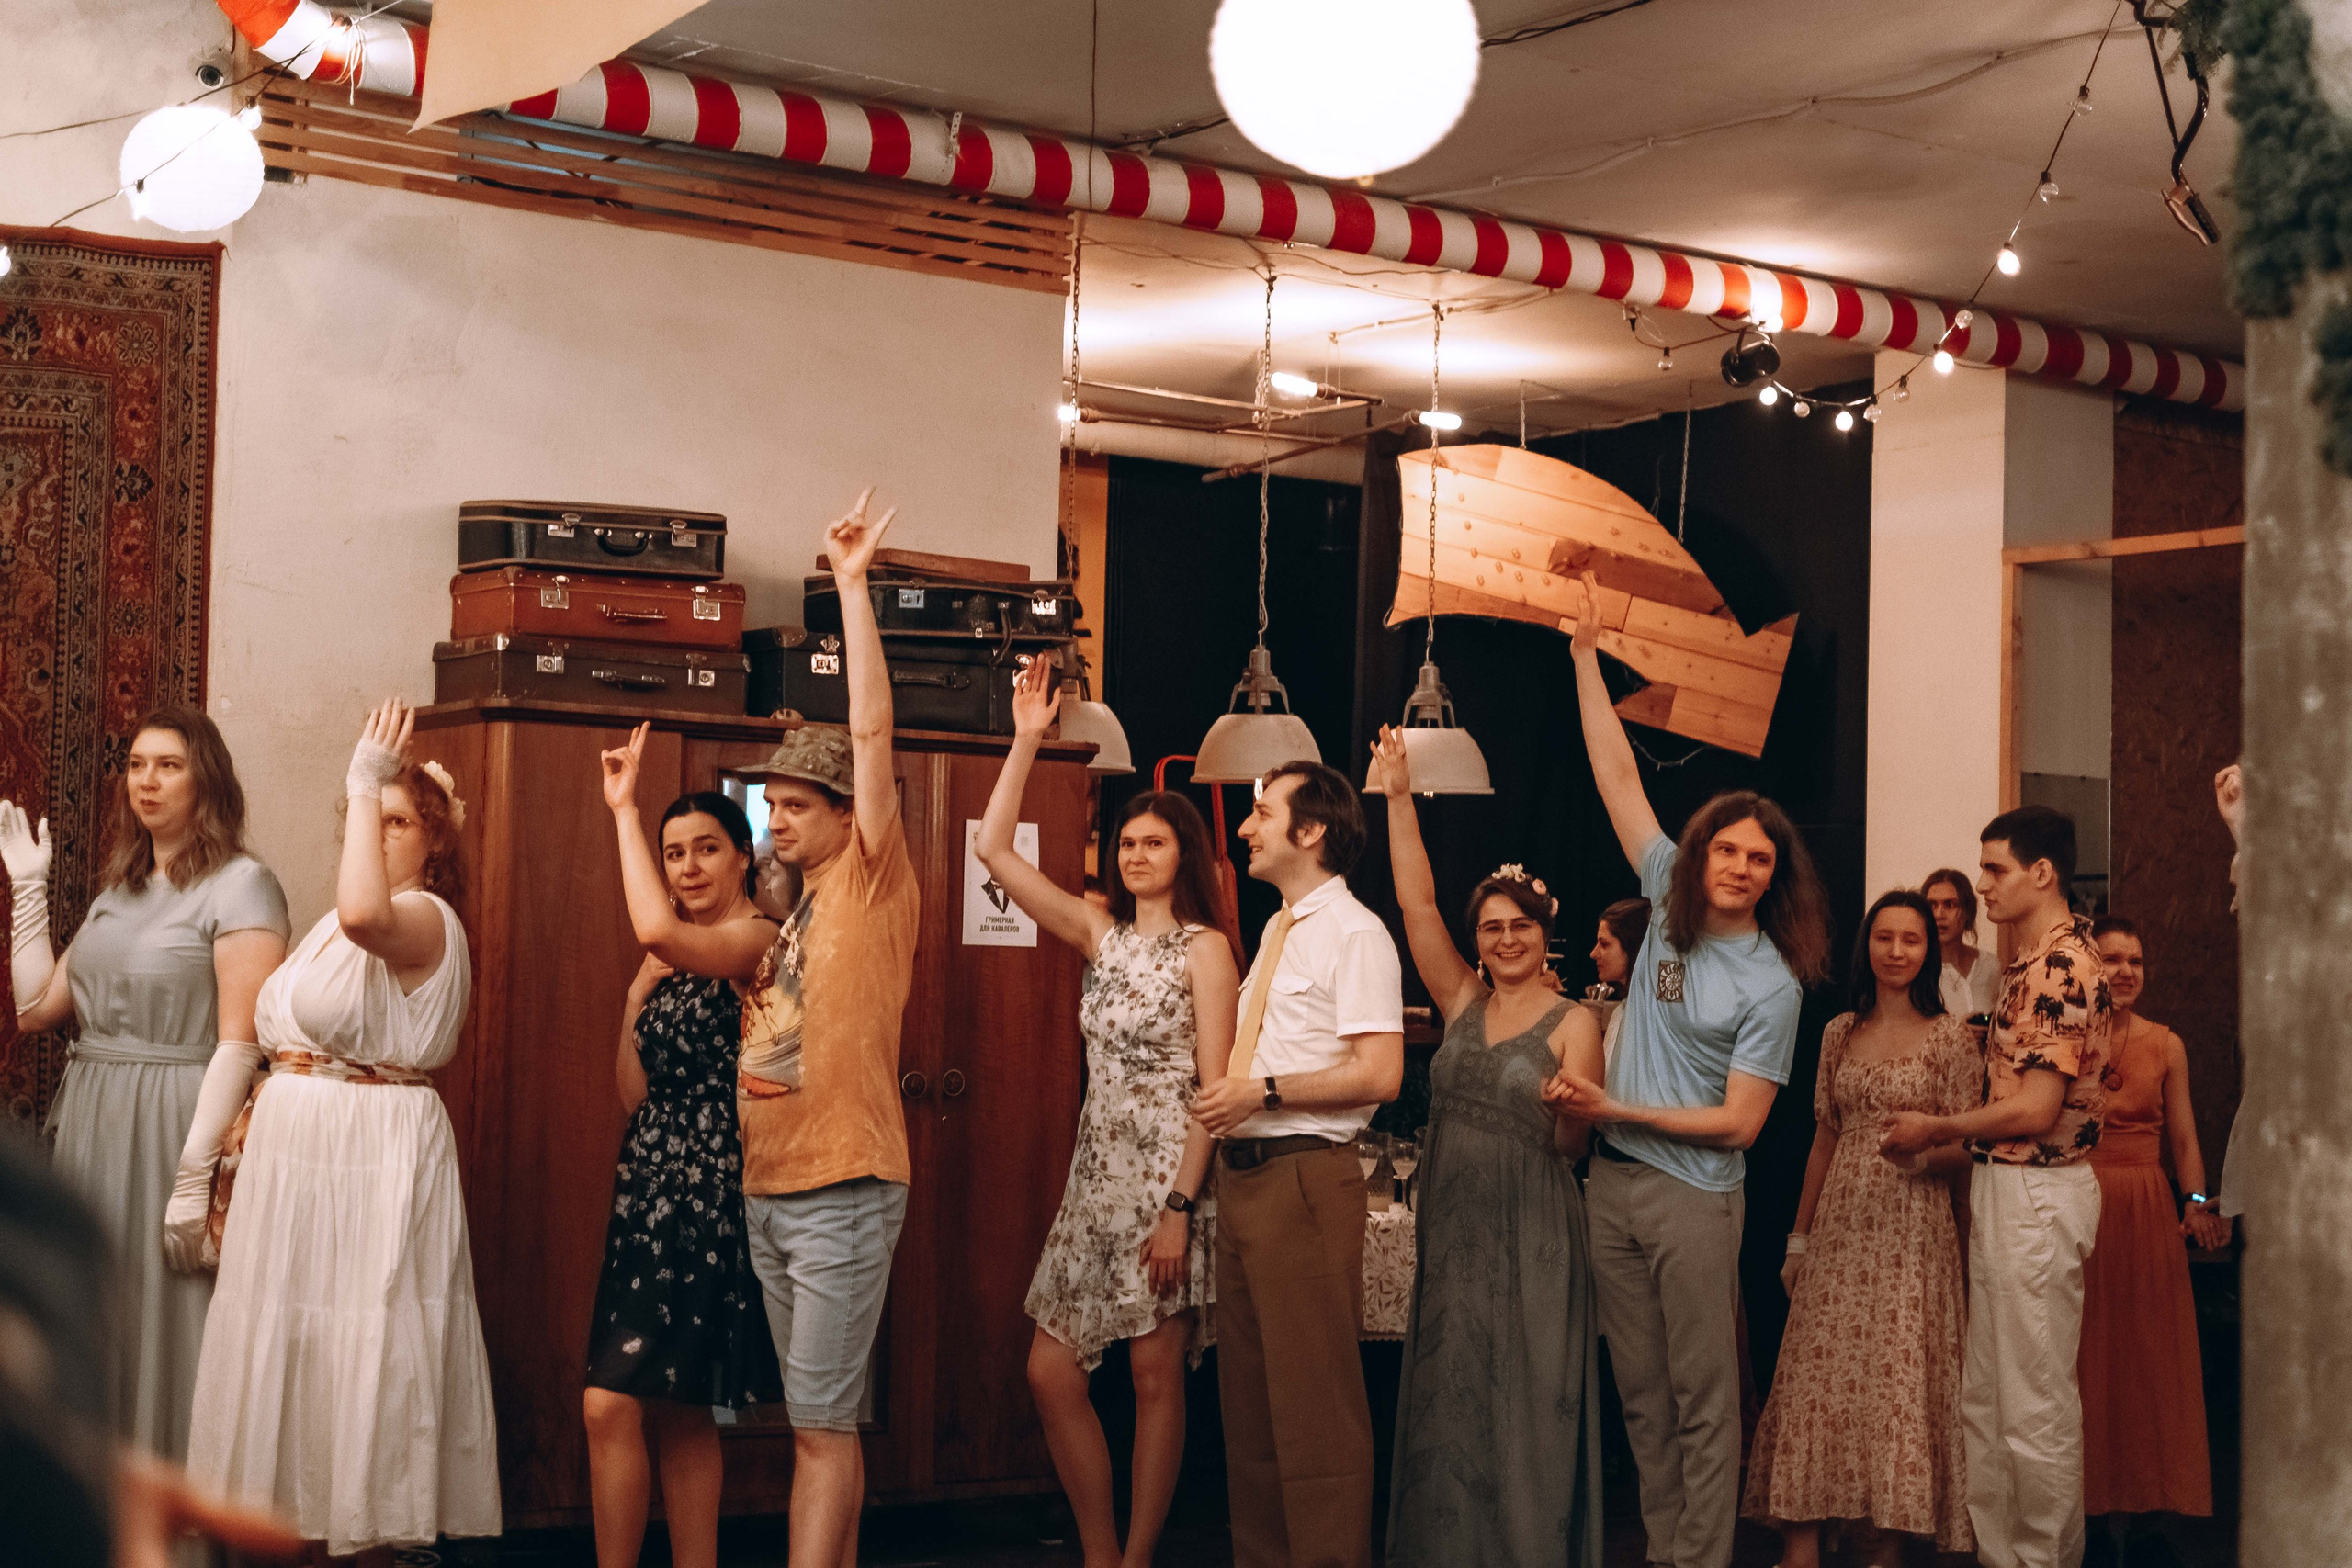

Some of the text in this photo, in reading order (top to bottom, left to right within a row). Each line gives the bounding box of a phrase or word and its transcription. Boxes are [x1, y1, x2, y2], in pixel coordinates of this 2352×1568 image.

[985, 916, 1014, 924] ГРИМЕРНАЯ
[979, 924, 1020, 933] ДЛЯ КАВАЛЕРОВ
